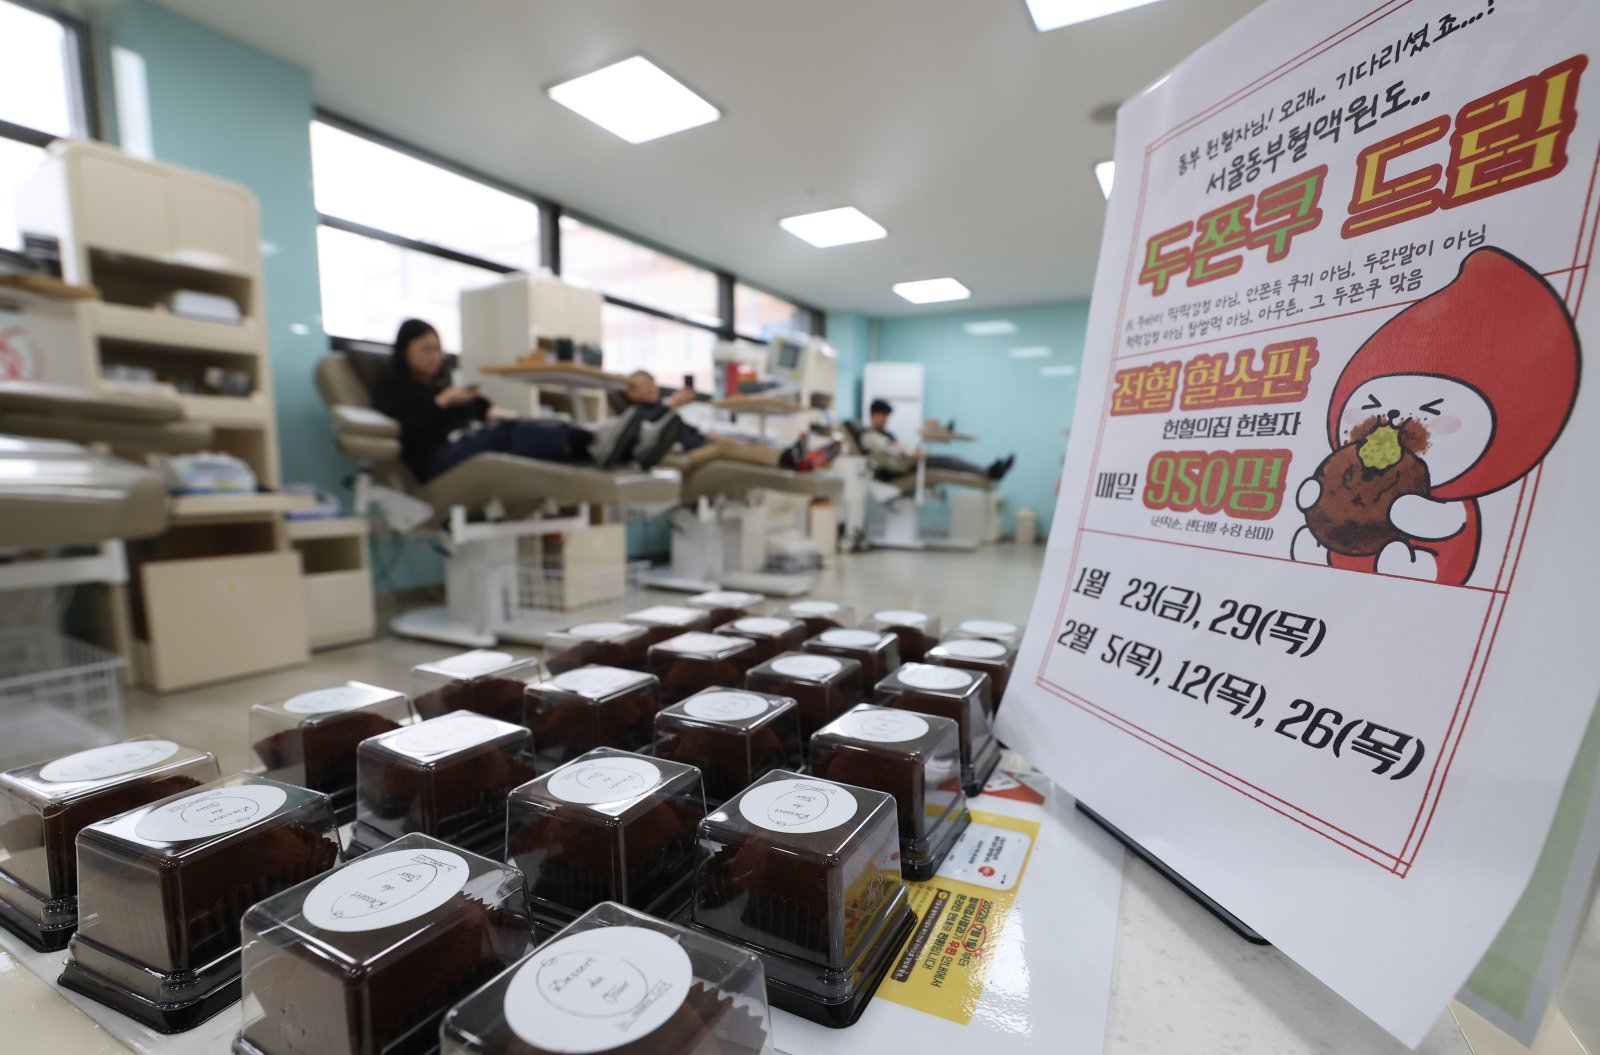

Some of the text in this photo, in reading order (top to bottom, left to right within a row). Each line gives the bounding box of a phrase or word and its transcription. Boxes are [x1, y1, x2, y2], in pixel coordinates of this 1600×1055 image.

[1206, 108, 1274, 160] 헌혈자님!
[1278, 87, 1326, 123] 오래..
[1206, 80, 1430, 194] 서울동부혈액원도..
[1138, 54, 1588, 297] 두쫀쿠 드림
[1246, 279, 1282, 304] 안쫀득
[1288, 272, 1314, 293] 쿠키
[1443, 223, 1487, 251] 아님
[1258, 297, 1304, 321] 아무튼..
[1309, 294, 1326, 310] 그
[1332, 278, 1382, 307] 두쫀쿠
[1389, 268, 1424, 294] 맞음
[1110, 337, 1320, 417] 전혈 혈소판
[1162, 412, 1302, 440] 헌혈의집 헌혈자
[1095, 449, 1293, 521] 매일 950명
[1185, 518, 1217, 536] 센터별
[1219, 522, 1243, 538] 수량
[1072, 567, 1327, 658] 1월 23(금), 29(목)
[1057, 619, 1426, 781] 2월 5(목), 12(목), 26(목)
[930, 956, 953, 988] 안내에서
[945, 940, 960, 955] 우편
